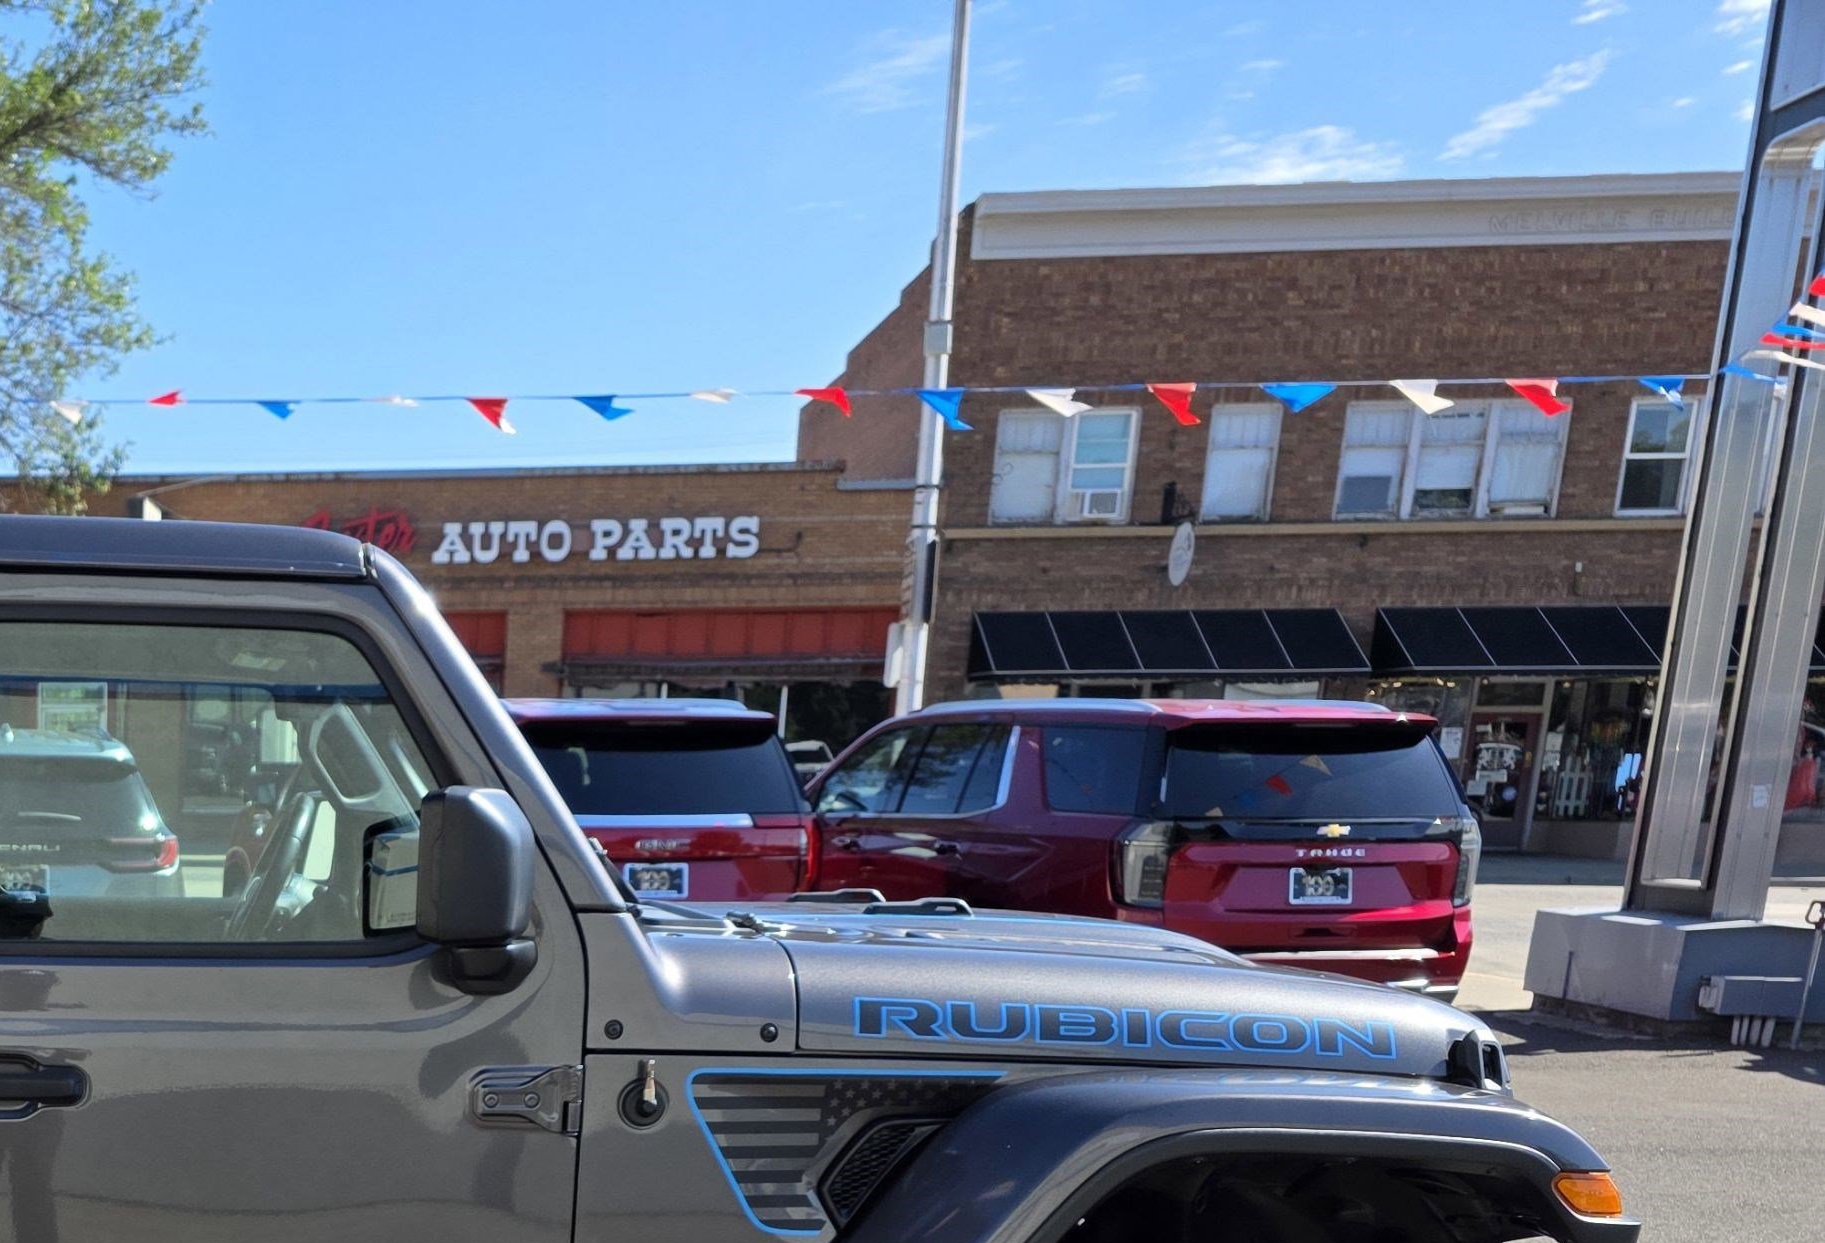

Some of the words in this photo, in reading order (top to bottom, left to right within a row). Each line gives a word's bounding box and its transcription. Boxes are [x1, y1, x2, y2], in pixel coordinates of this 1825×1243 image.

[432, 519, 572, 564] AUTO
[589, 515, 761, 560] PARTS
[1294, 847, 1366, 857] TAHOE
[851, 996, 1399, 1060] RUBICON
